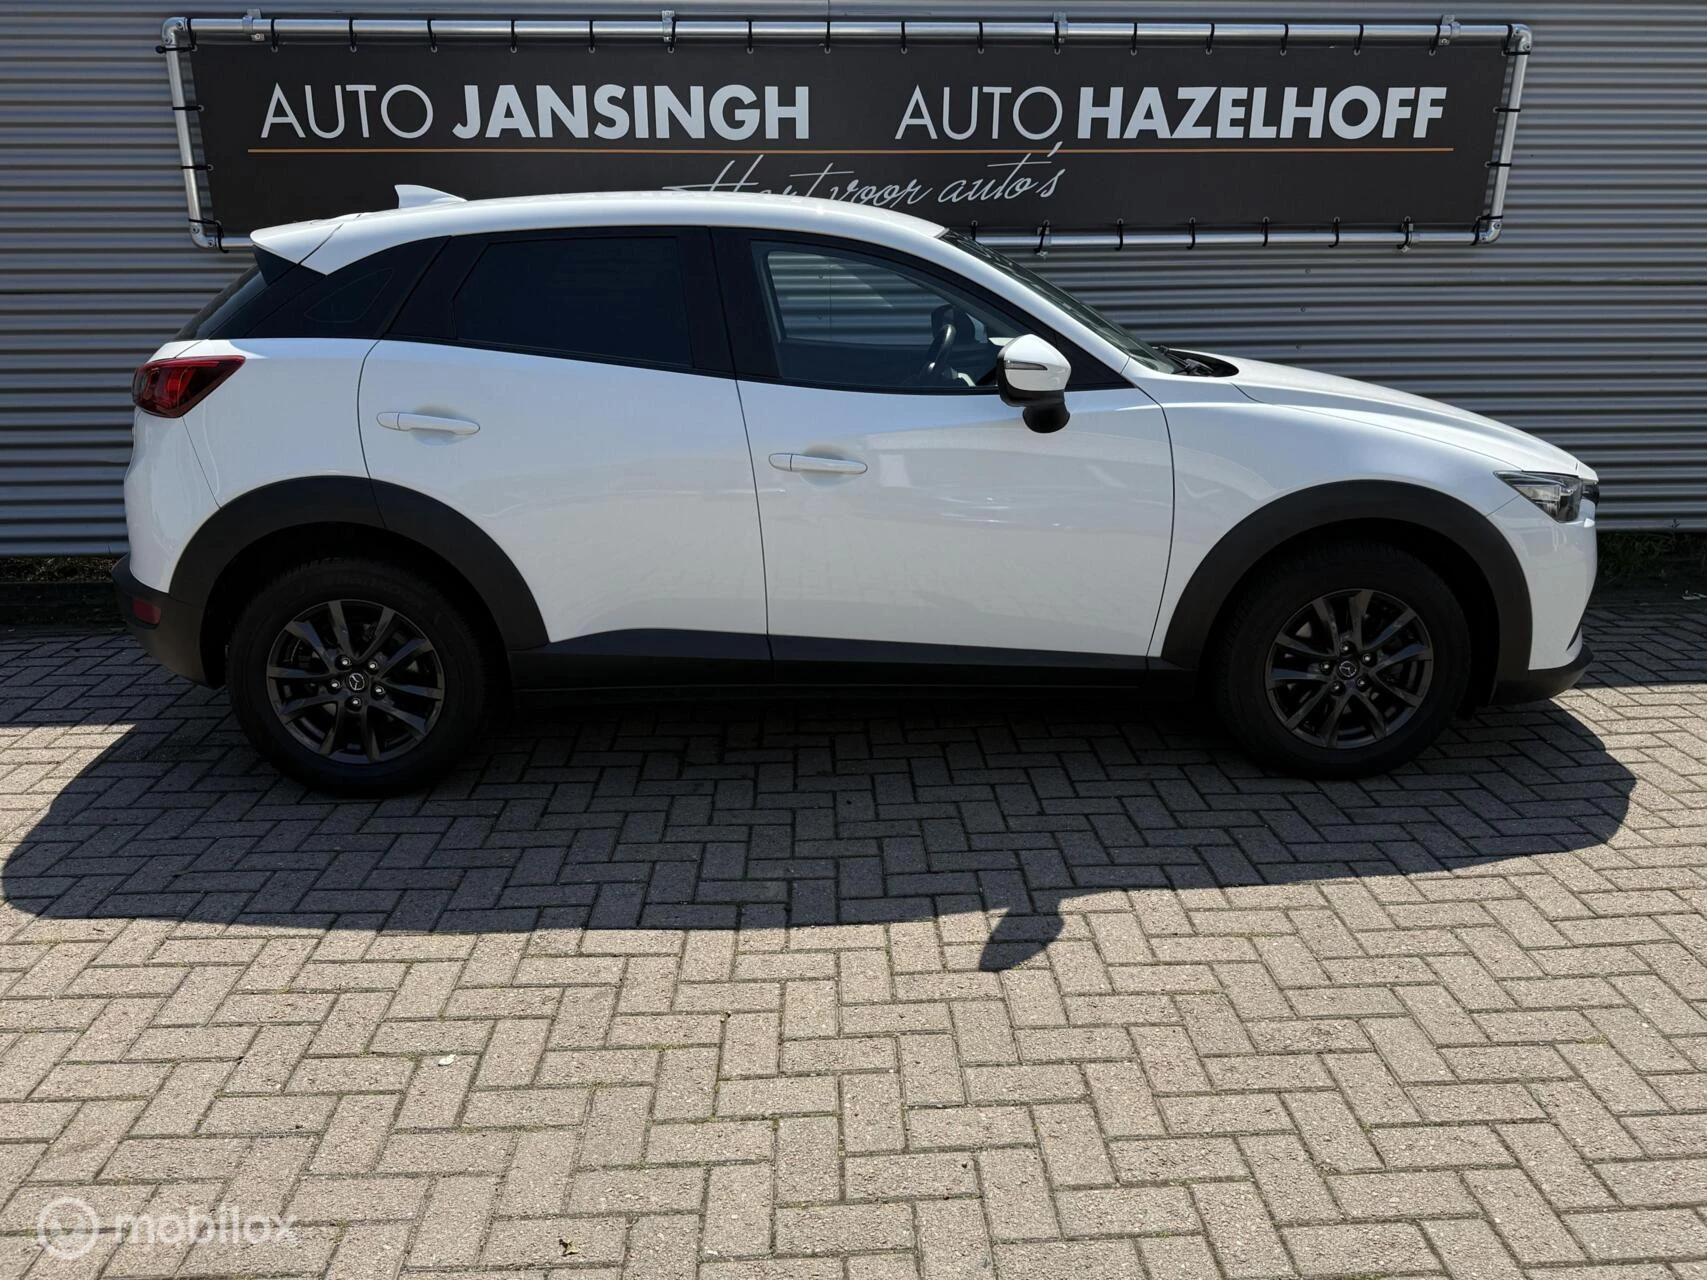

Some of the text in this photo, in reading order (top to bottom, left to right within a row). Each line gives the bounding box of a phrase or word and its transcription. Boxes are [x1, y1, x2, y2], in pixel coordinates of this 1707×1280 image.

[260, 83, 810, 140] AUTO JANSINGH
[894, 84, 1448, 140] AUTO HAZELHOFF
[937, 141, 1066, 203] auto's
